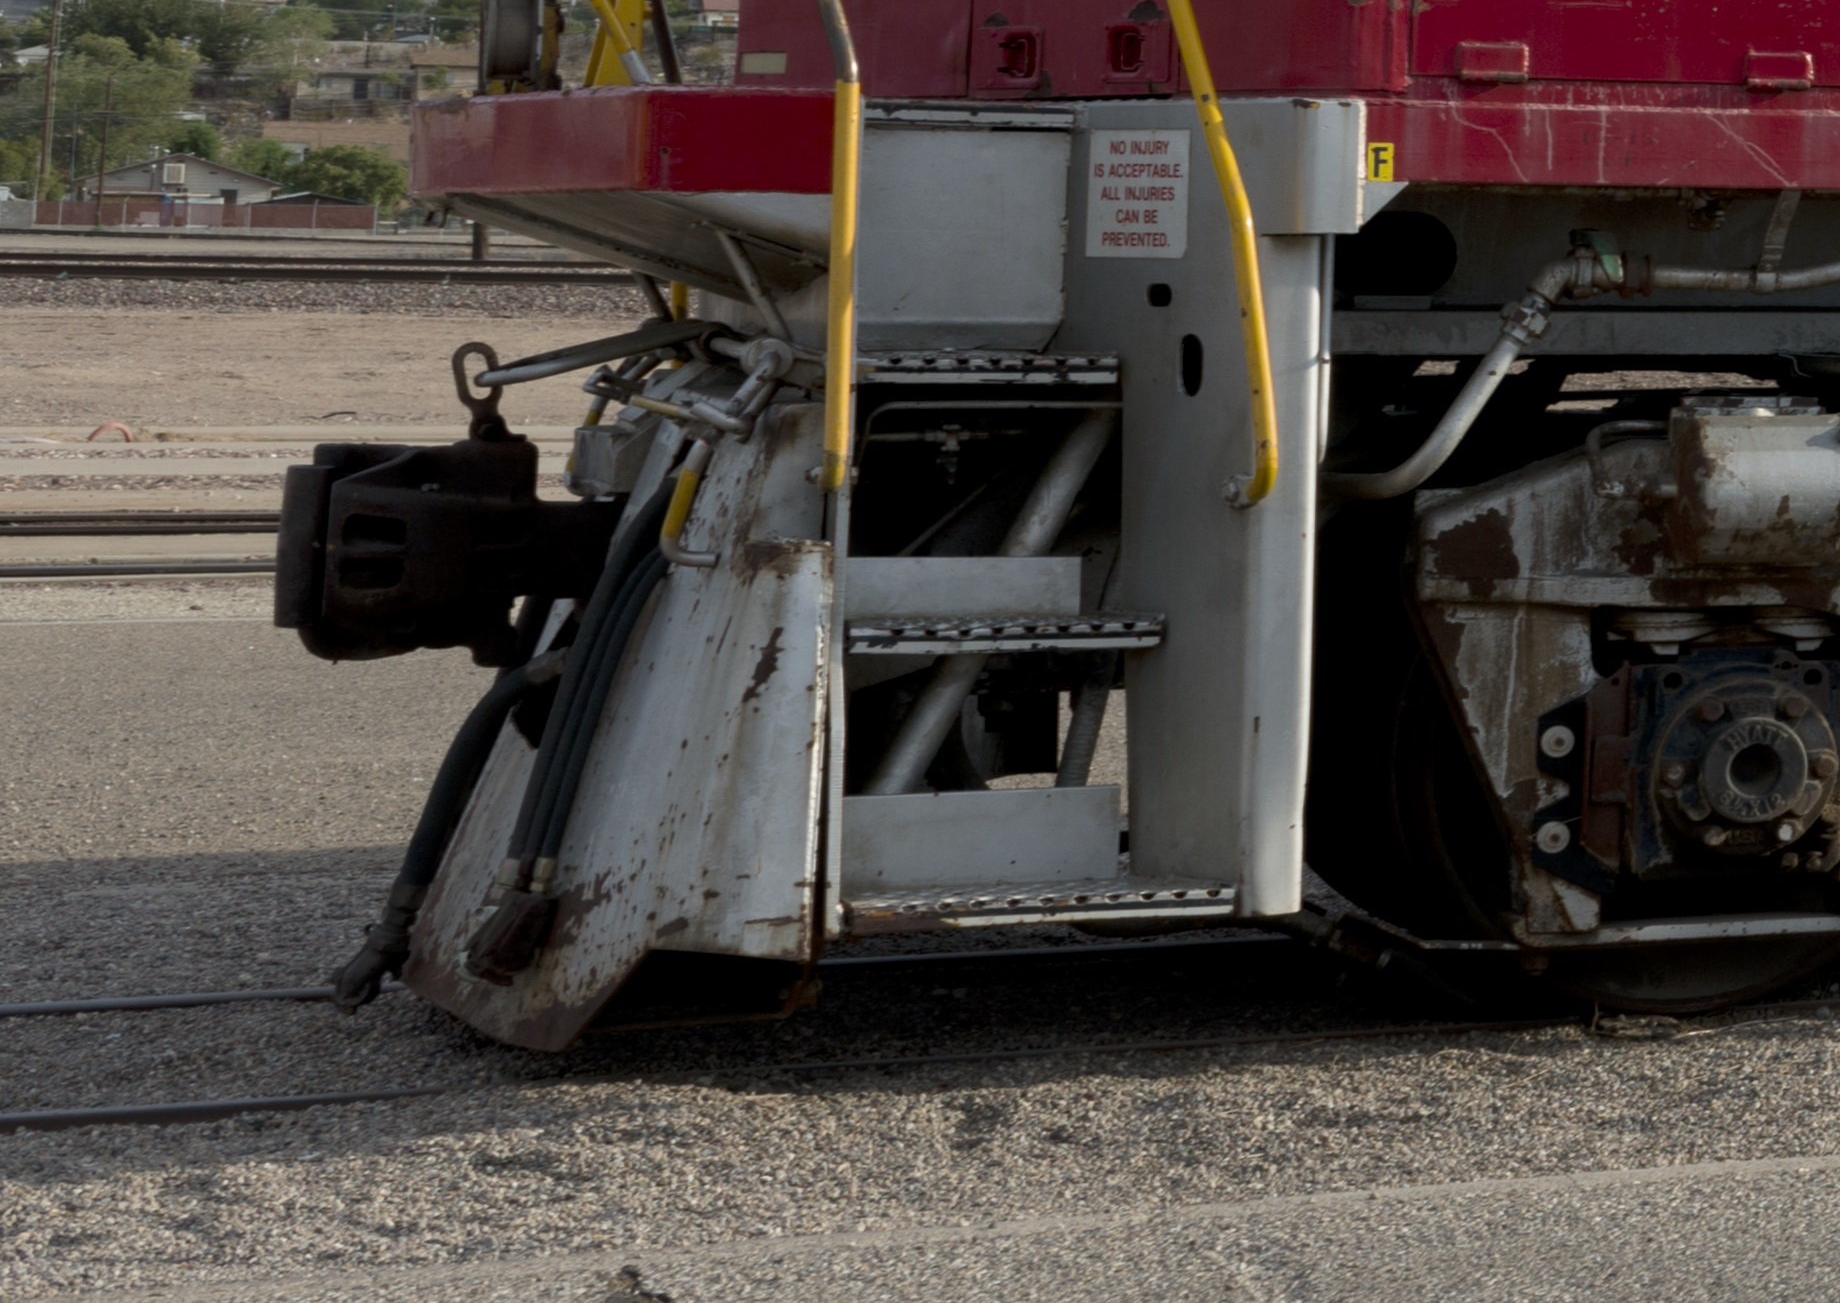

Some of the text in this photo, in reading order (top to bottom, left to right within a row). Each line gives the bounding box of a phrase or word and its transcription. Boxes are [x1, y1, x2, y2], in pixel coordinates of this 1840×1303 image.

[1109, 141, 1170, 155] NO INJURY
[1373, 147, 1388, 178] F
[1094, 163, 1184, 179] IS ACCEPTABLE.
[1101, 186, 1175, 201] ALL INJURIES
[1116, 209, 1158, 224] CAN BE
[1102, 233, 1170, 247] PREVENTED.
[1724, 724, 1789, 751] HYATT
